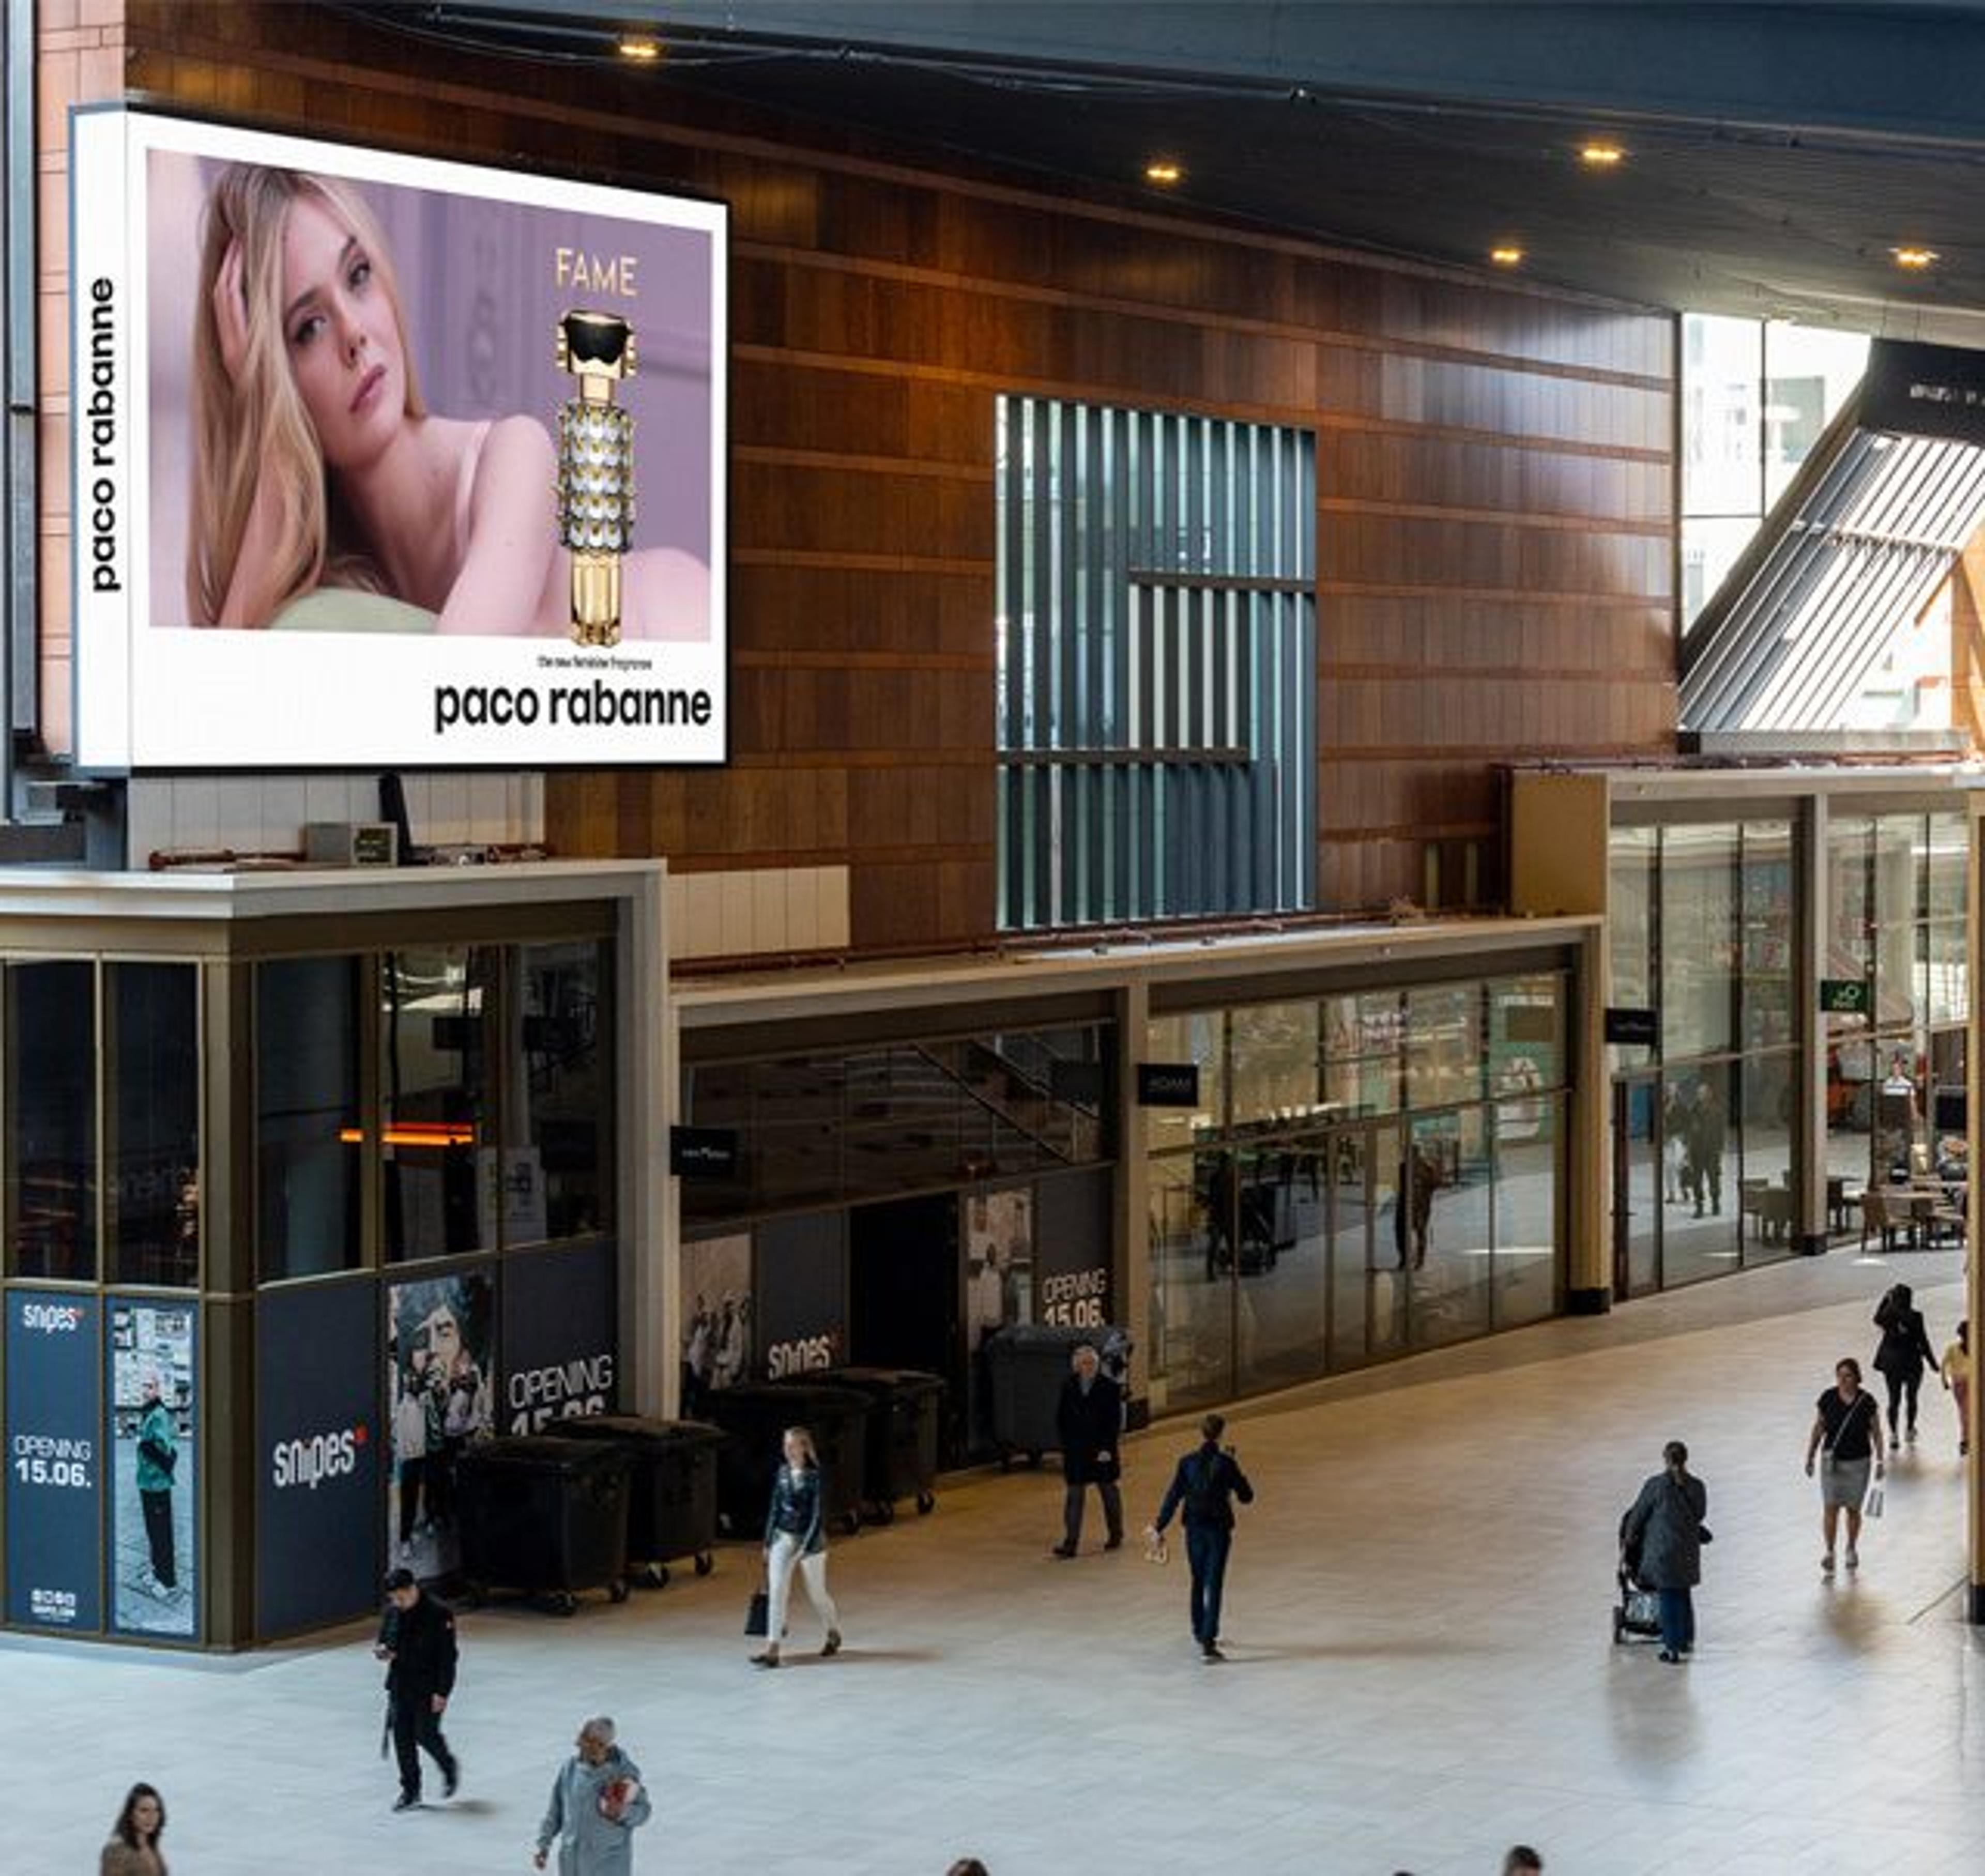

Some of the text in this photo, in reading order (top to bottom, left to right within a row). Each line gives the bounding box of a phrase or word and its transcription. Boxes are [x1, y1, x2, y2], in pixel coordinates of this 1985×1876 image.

[555, 248, 637, 297] FAME
[87, 278, 121, 592] paco rabanne
[435, 679, 712, 734] paco rabanne
[1043, 1268, 1105, 1303] OPENING
[23, 1304, 76, 1334] snipes
[509, 1355, 612, 1409] OPENING
[14, 1435, 91, 1461] OPENING
[15, 1457, 91, 1488] 15.06.
[273, 1428, 356, 1489] snipes
